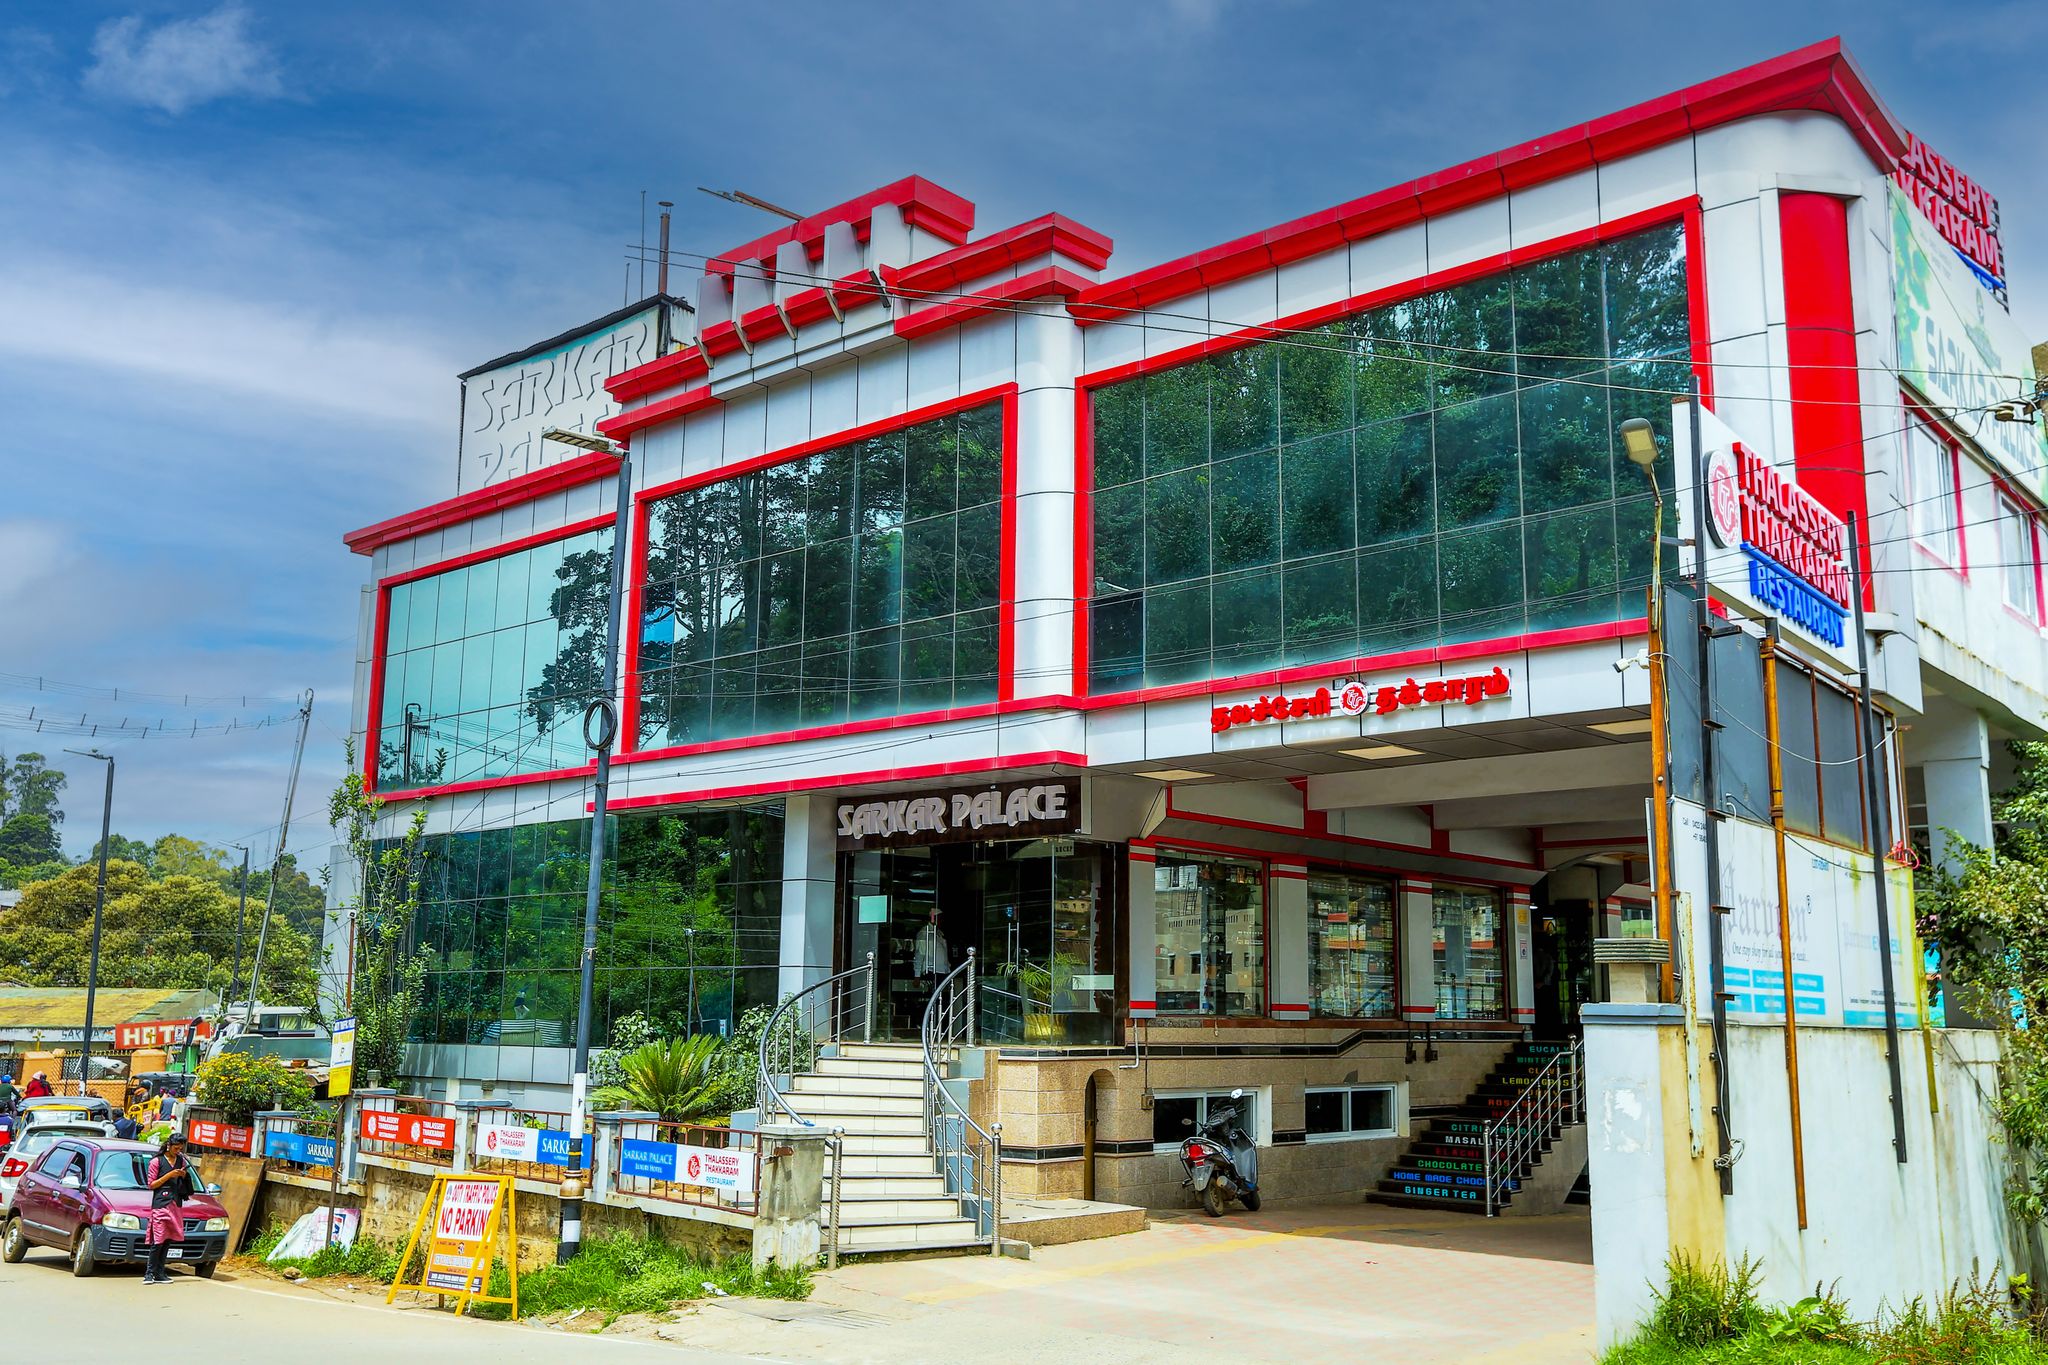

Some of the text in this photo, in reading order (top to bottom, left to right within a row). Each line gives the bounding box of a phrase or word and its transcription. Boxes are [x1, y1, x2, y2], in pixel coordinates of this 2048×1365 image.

[1901, 133, 1995, 230] ASSERY
[1891, 166, 2001, 277] KKARAM
[474, 321, 645, 433] SARKAR
[1733, 441, 1847, 561] THALASSERY
[1739, 493, 1850, 609] THAKKARAM
[1748, 560, 1845, 648] RESTAURANT
[838, 784, 1066, 840] SARKAR PALACE
[623, 1149, 673, 1165] SARKAR PALACE
[705, 1153, 740, 1167] THALASSERY
[705, 1163, 740, 1176] THAKKARAM
[1417, 1159, 1483, 1172] CHOCOLATE
[705, 1175, 736, 1187] RESTAURANT
[1393, 1171, 1421, 1181] HOME
[1424, 1173, 1453, 1184] MADE
[1404, 1186, 1477, 1200] GINGER TEA
[439, 1207, 493, 1236] NO PARKIN
